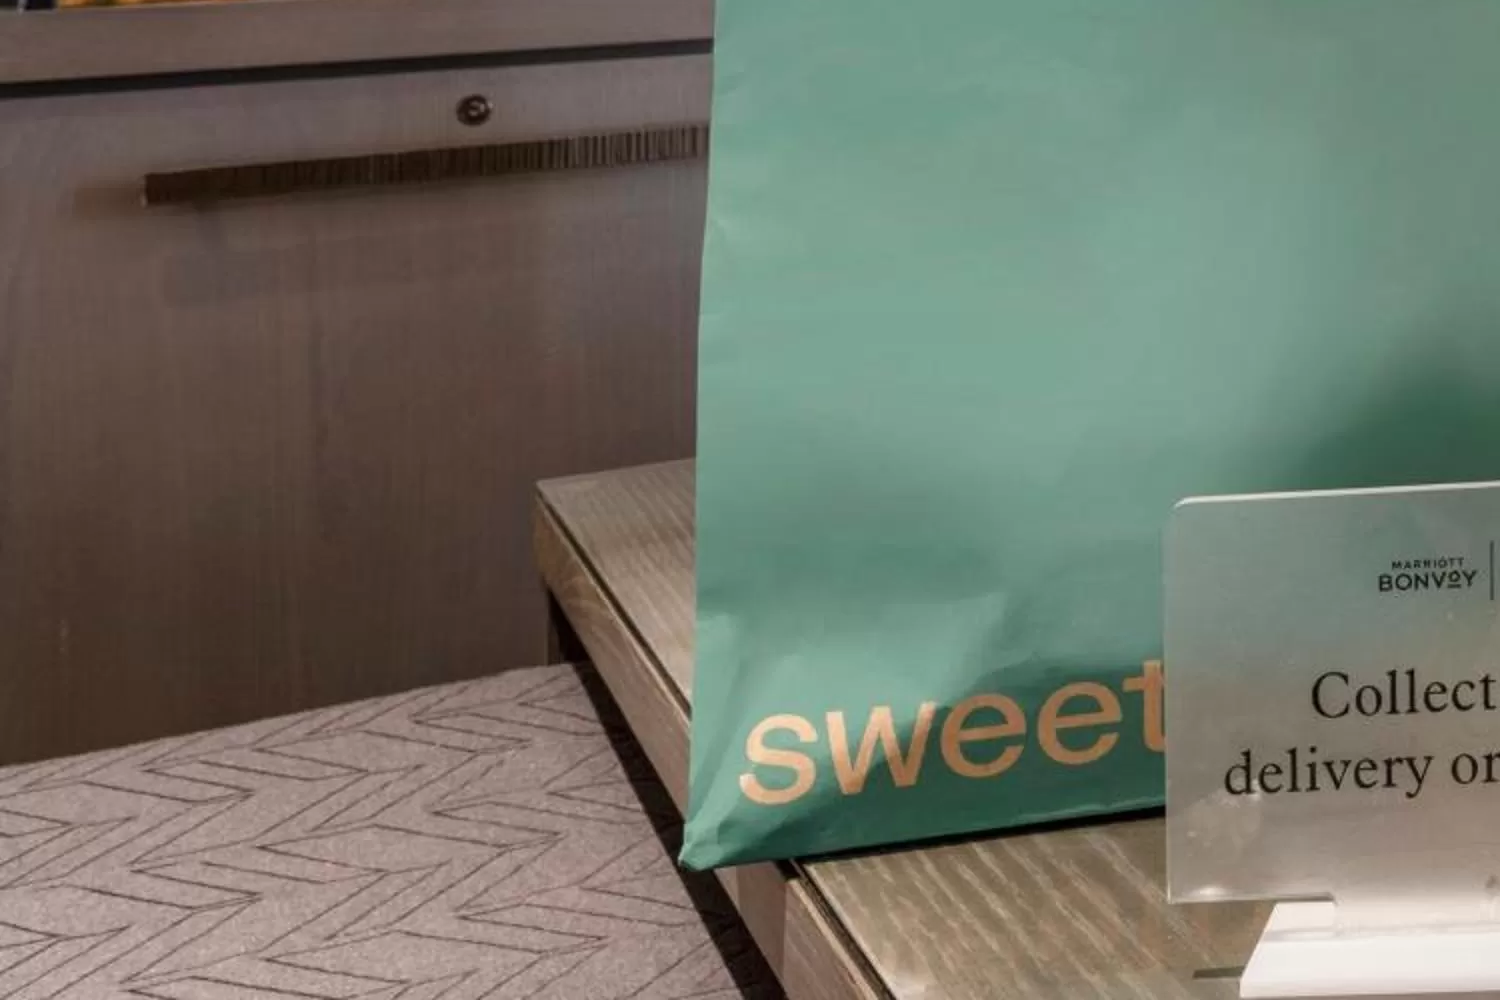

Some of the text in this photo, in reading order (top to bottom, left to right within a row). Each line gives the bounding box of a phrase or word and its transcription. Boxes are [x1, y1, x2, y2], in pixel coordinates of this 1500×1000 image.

[1378, 569, 1478, 592] BONVOY
[1391, 556, 1465, 570] MARRIOTT
[1311, 668, 1497, 720] Collect
[738, 659, 1166, 805] sweet
[1224, 745, 1433, 799] delivery
